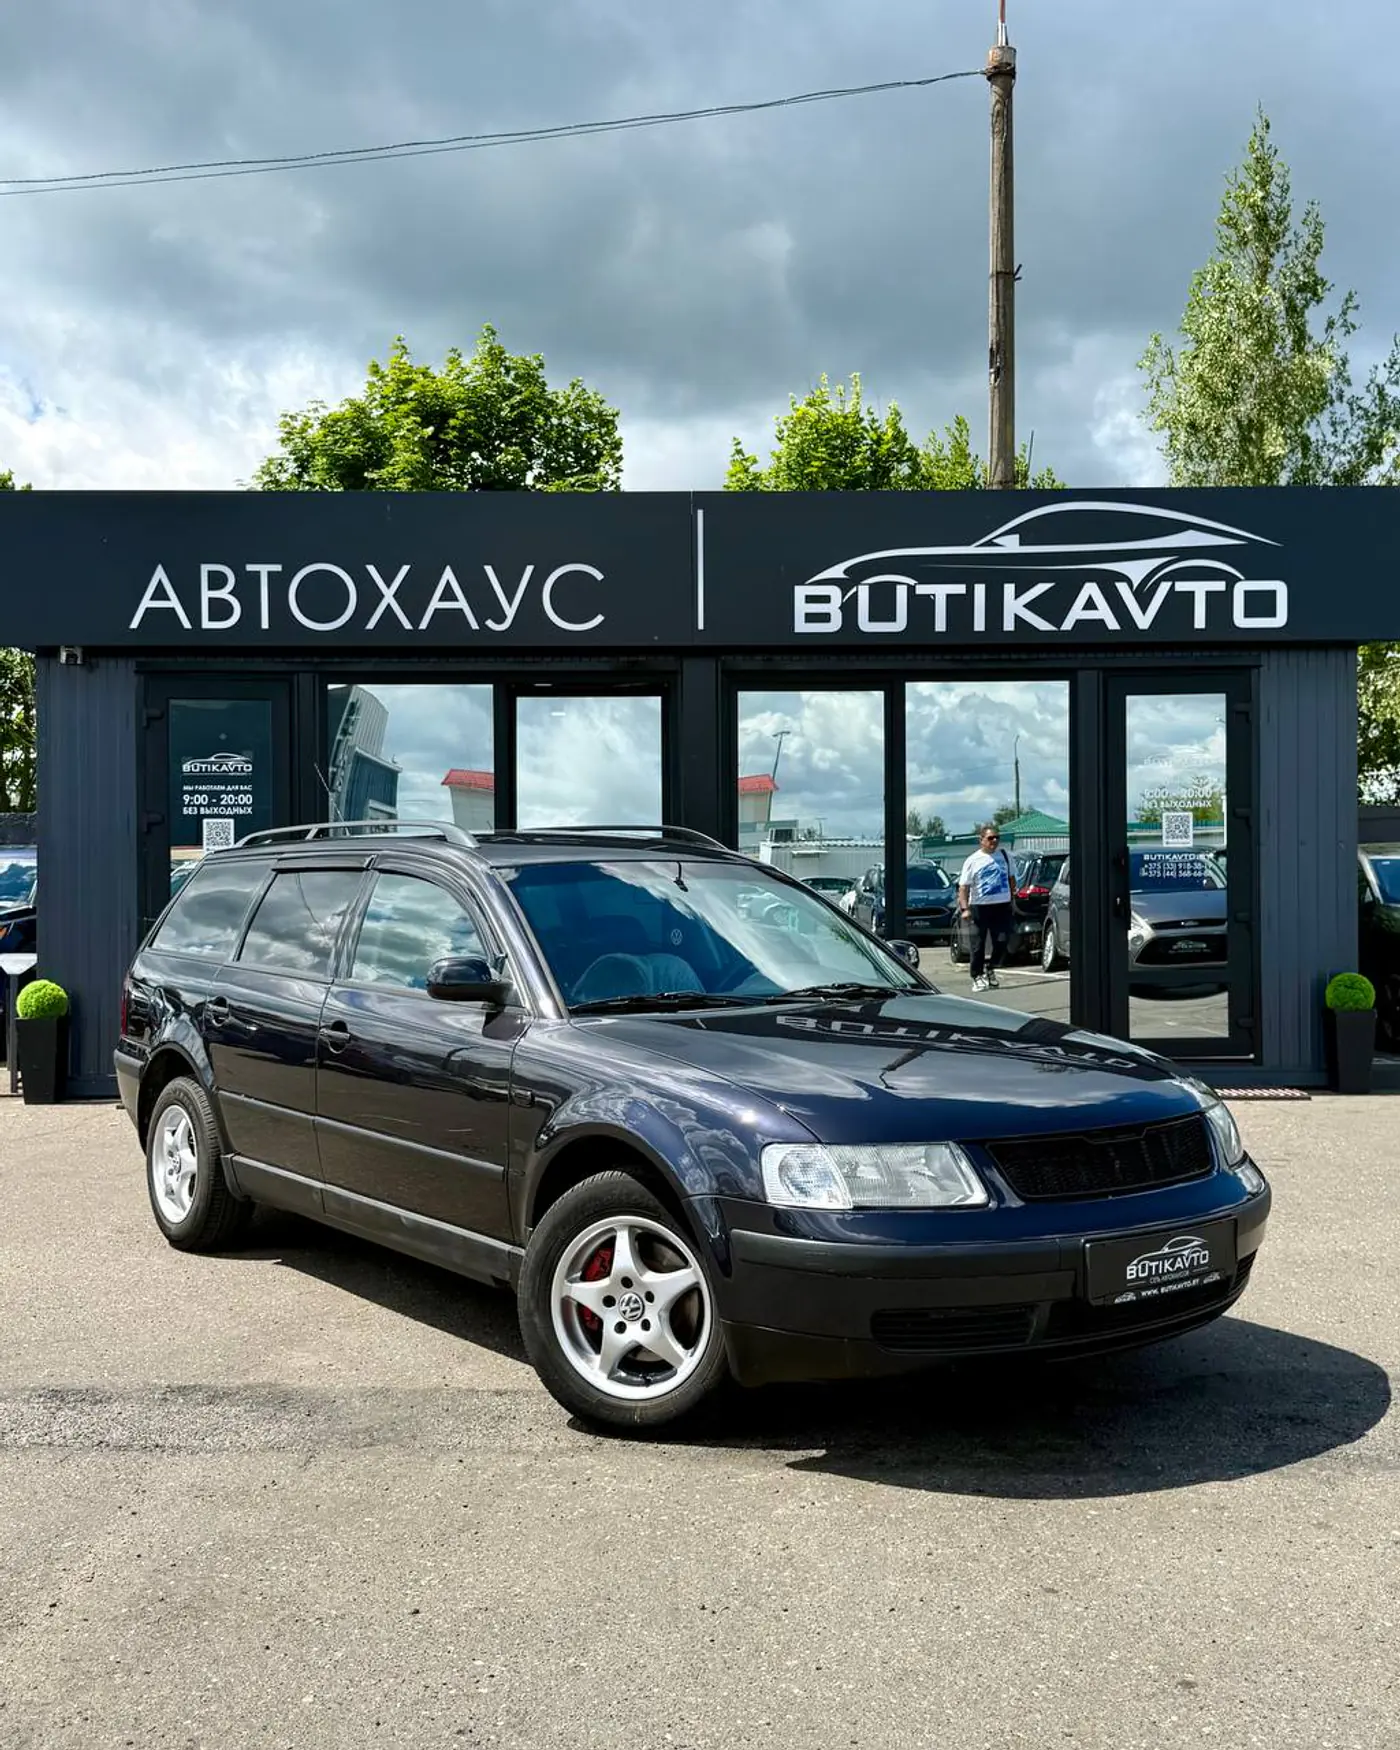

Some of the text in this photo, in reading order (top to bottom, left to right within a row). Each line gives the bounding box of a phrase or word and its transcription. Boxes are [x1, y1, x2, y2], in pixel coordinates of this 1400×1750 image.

[129, 562, 605, 631] АВТОХАУС
[794, 579, 1288, 633] BUTIKAVTO
[182, 763, 253, 772] BUTIKAVTO
[183, 794, 208, 806] 9:00
[220, 794, 253, 806] 20:00
[183, 806, 253, 815] БЕЗ ВЫХОДНЫХ
[1126, 1250, 1209, 1280] BUTIKAVTO
